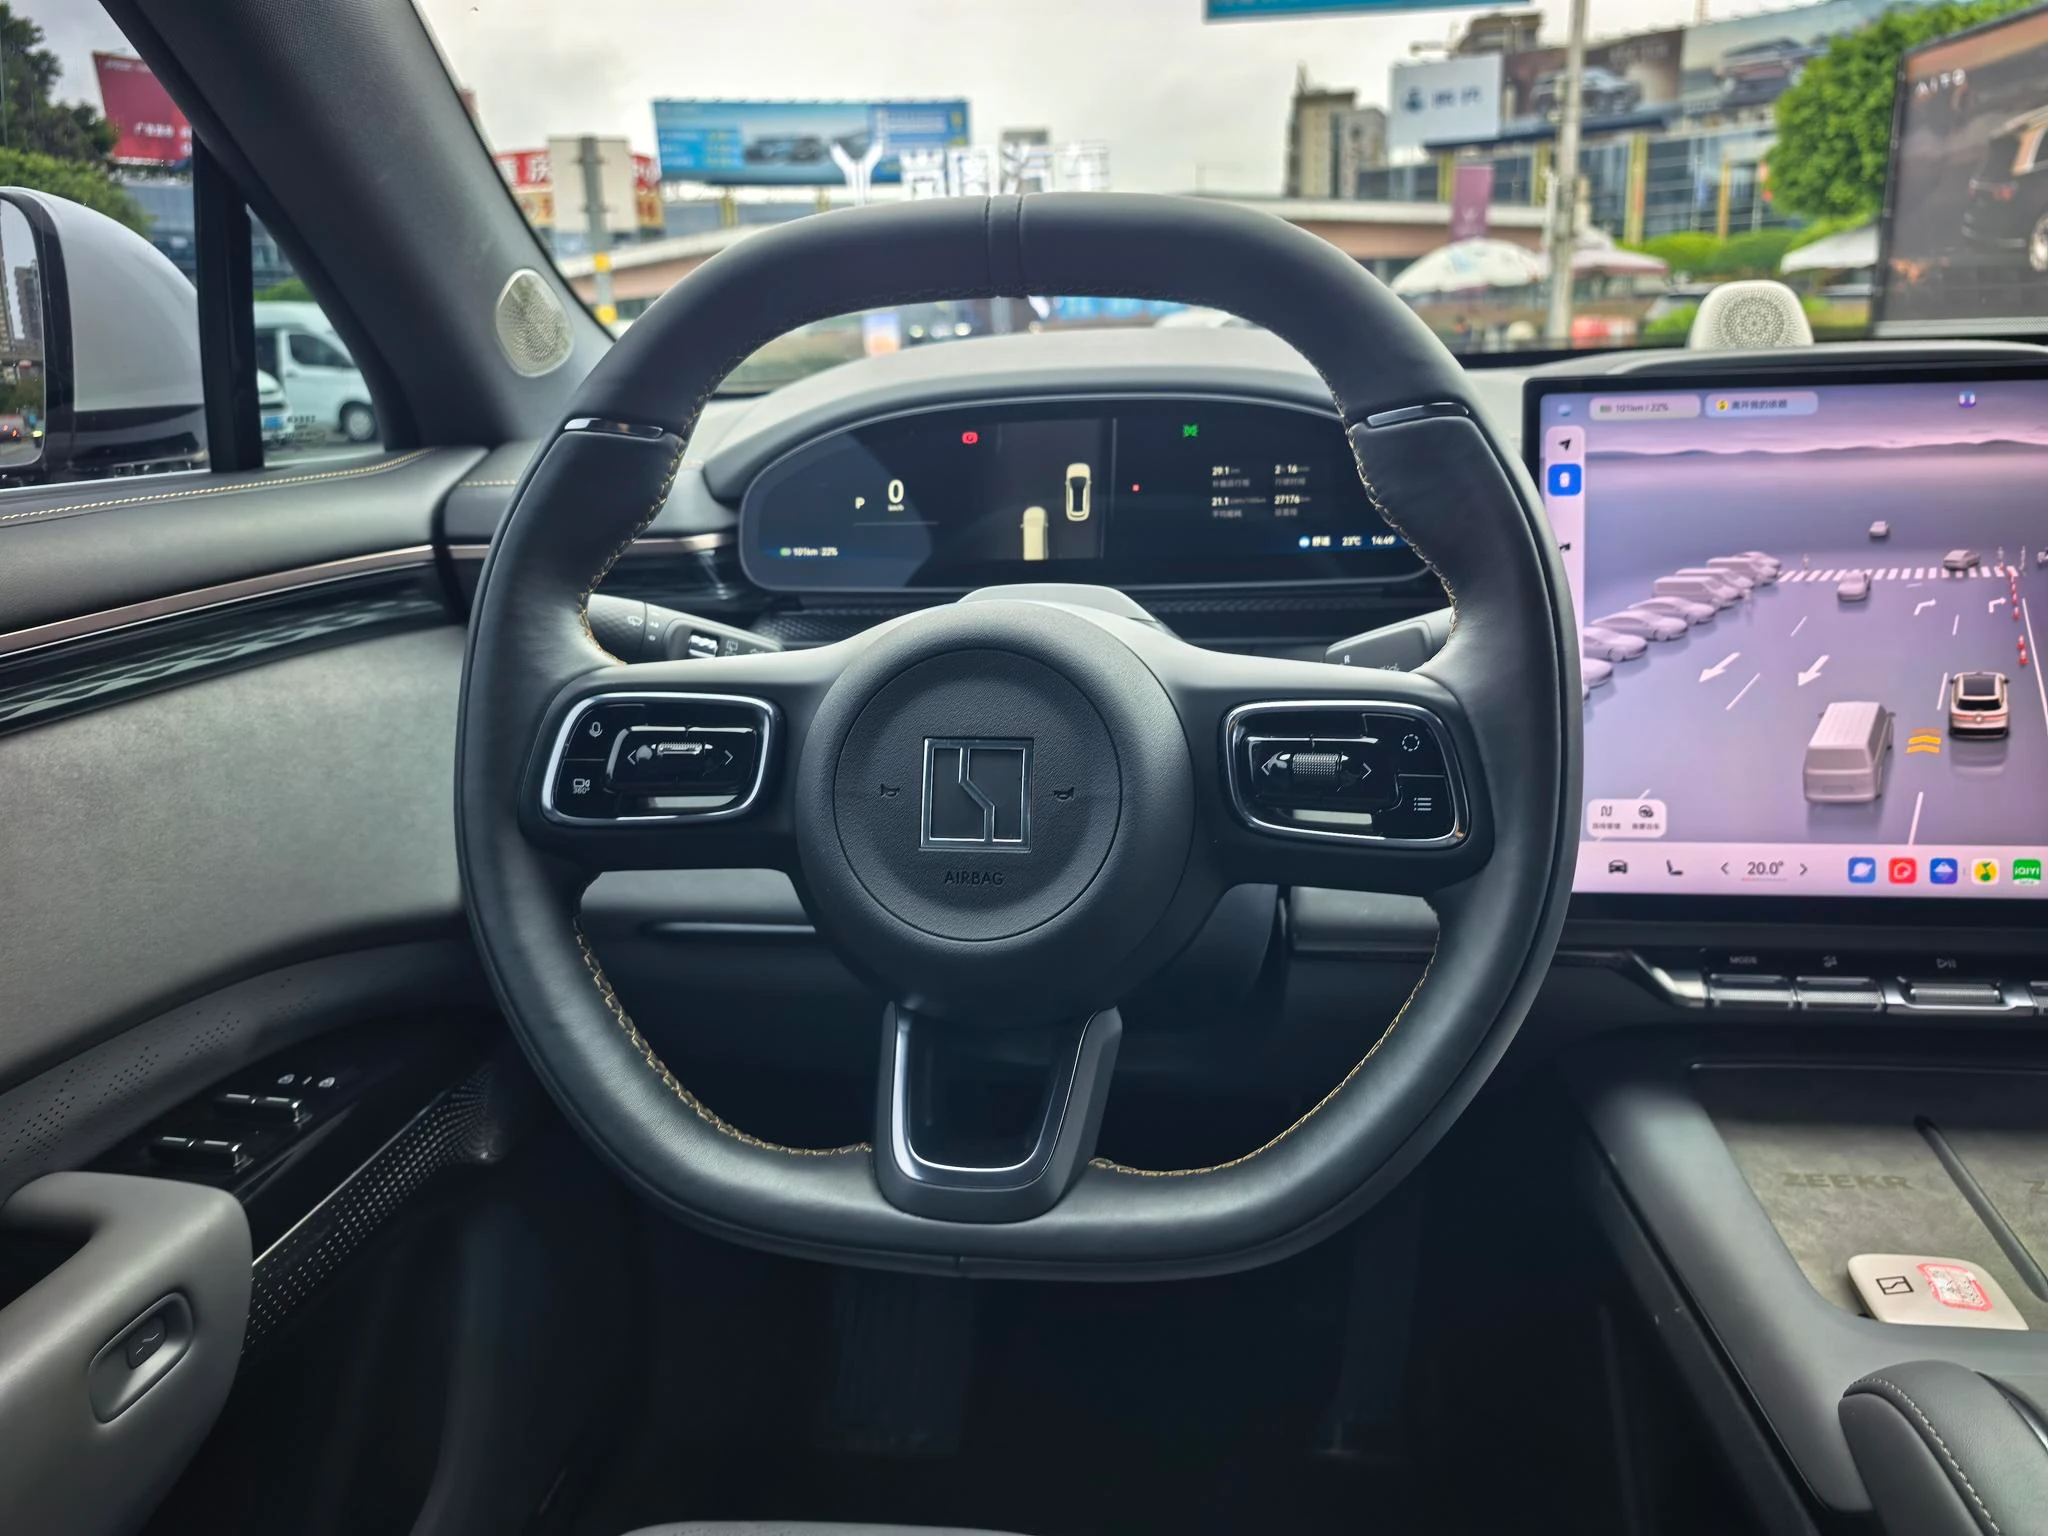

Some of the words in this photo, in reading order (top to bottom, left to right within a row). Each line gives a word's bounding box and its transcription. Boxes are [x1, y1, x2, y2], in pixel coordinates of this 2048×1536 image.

[888, 479, 904, 504] 0
[855, 497, 865, 510] P
[1747, 860, 1784, 875] 20.0°
[944, 870, 1004, 886] AIRBAG
[1781, 1172, 1914, 1190] ZEEKR
